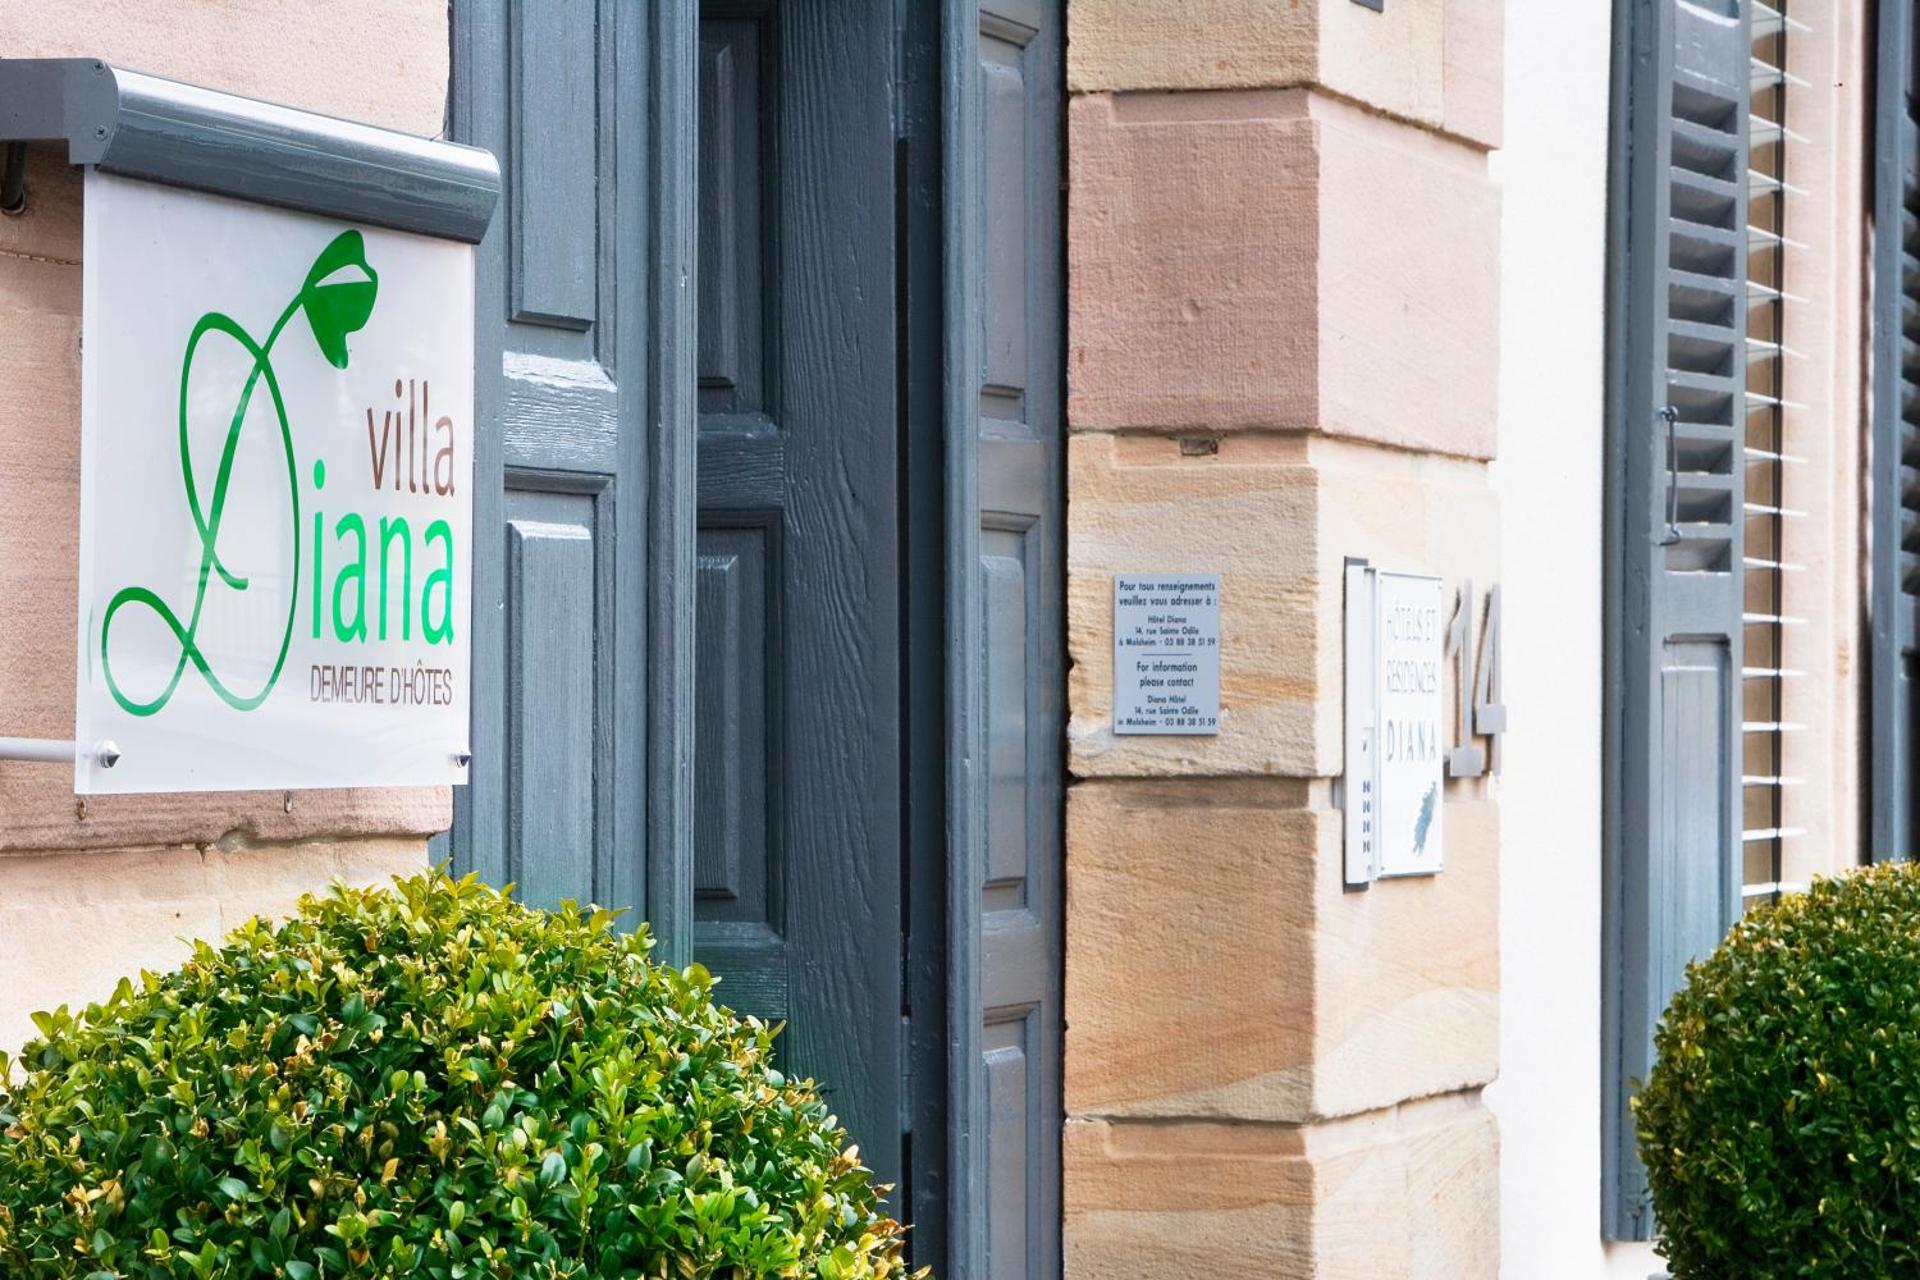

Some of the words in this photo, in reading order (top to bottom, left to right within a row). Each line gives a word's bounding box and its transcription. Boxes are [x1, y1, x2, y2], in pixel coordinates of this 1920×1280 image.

[367, 379, 455, 497] villa
[1119, 580, 1136, 591] Pour
[1139, 582, 1154, 591] tous
[1158, 580, 1215, 593] renseignements
[1119, 595, 1147, 606] veuillez
[1150, 598, 1168, 606] vous
[1170, 595, 1203, 606] adresser
[1167, 615, 1187, 624] Diana
[1160, 626, 1179, 635] Sainte
[1182, 626, 1199, 635] Odile
[1136, 661, 1149, 671] For
[1152, 660, 1198, 671] information
[310, 664, 384, 704] DEMEURE
[390, 658, 452, 706] D'HÔTES
[1140, 676, 1164, 688] please
[1167, 677, 1194, 687] contact
[1445, 579, 1506, 777] 14
[1147, 695, 1167, 703] Diana
[1160, 706, 1179, 715] Sainte
[1181, 706, 1199, 715] Odile
[1164, 718, 1174, 726] 03
[1207, 718, 1216, 726] 59
[1386, 718, 1437, 762] DIANA
